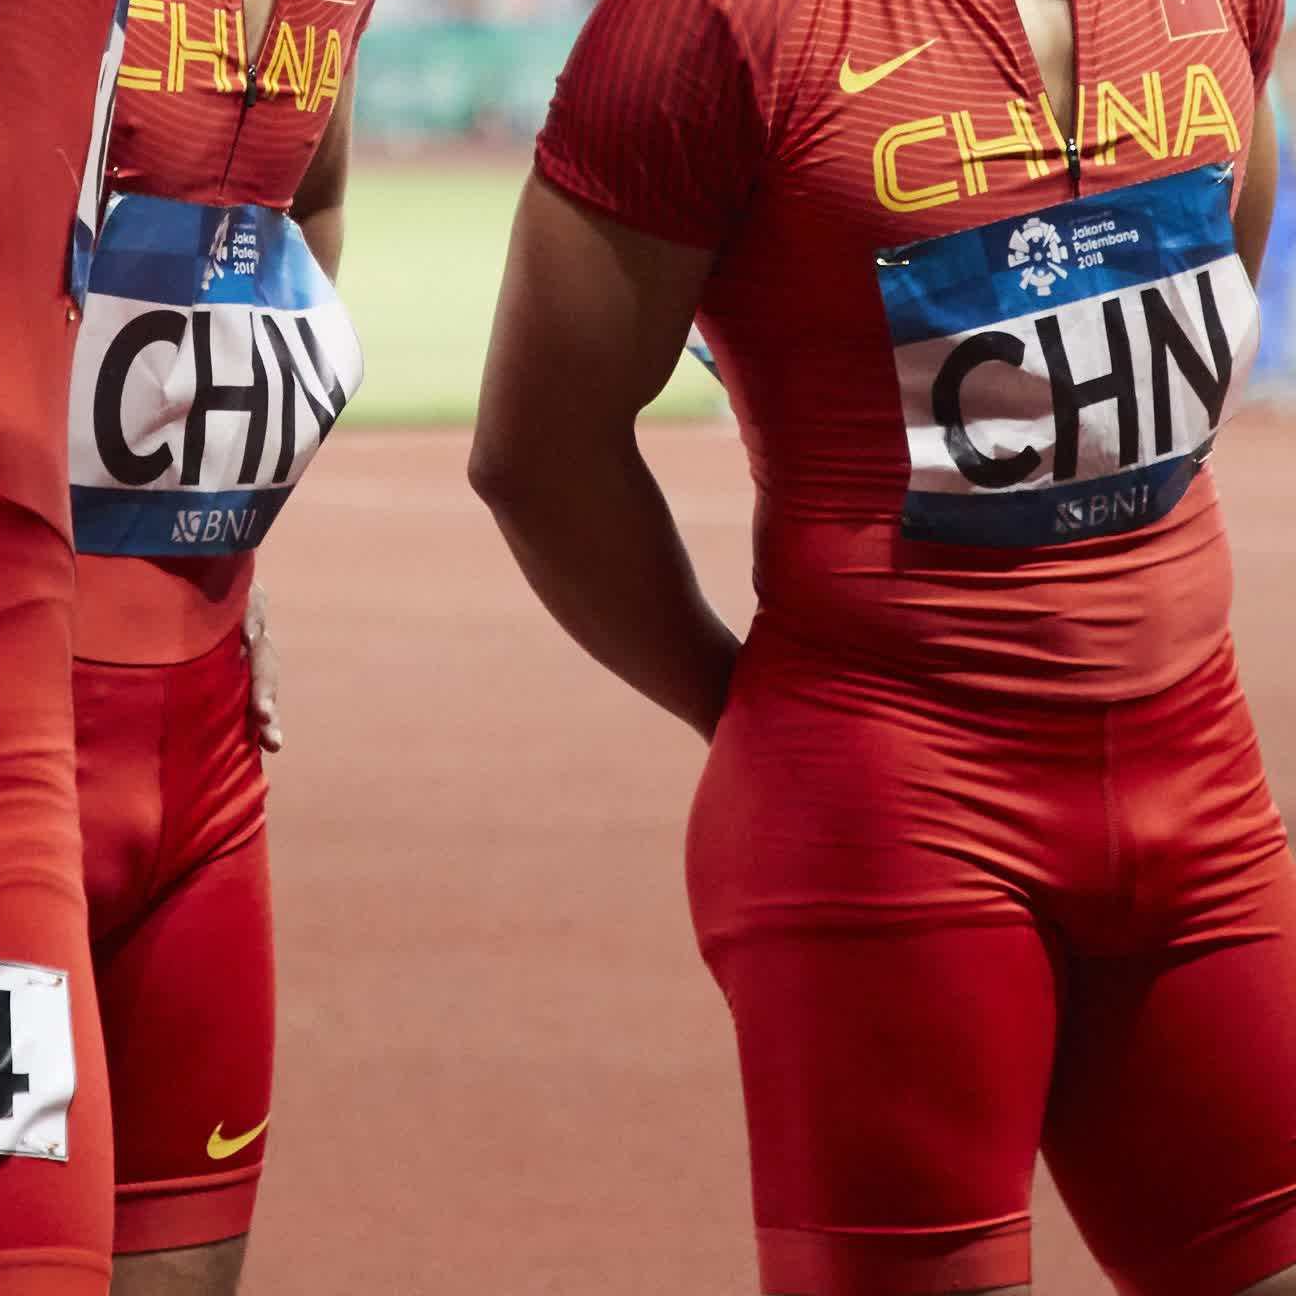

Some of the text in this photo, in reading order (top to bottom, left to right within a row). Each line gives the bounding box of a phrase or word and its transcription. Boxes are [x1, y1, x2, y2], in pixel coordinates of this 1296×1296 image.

[873, 64, 1241, 213] CHINA
[1071, 220, 1116, 241] Jakarta
[1072, 229, 1140, 254] Palembang
[1077, 251, 1104, 270] 2018
[93, 309, 347, 486] CHN
[932, 271, 1233, 488] CHN
[1087, 485, 1149, 526] BNI
[201, 508, 257, 542] BNI
